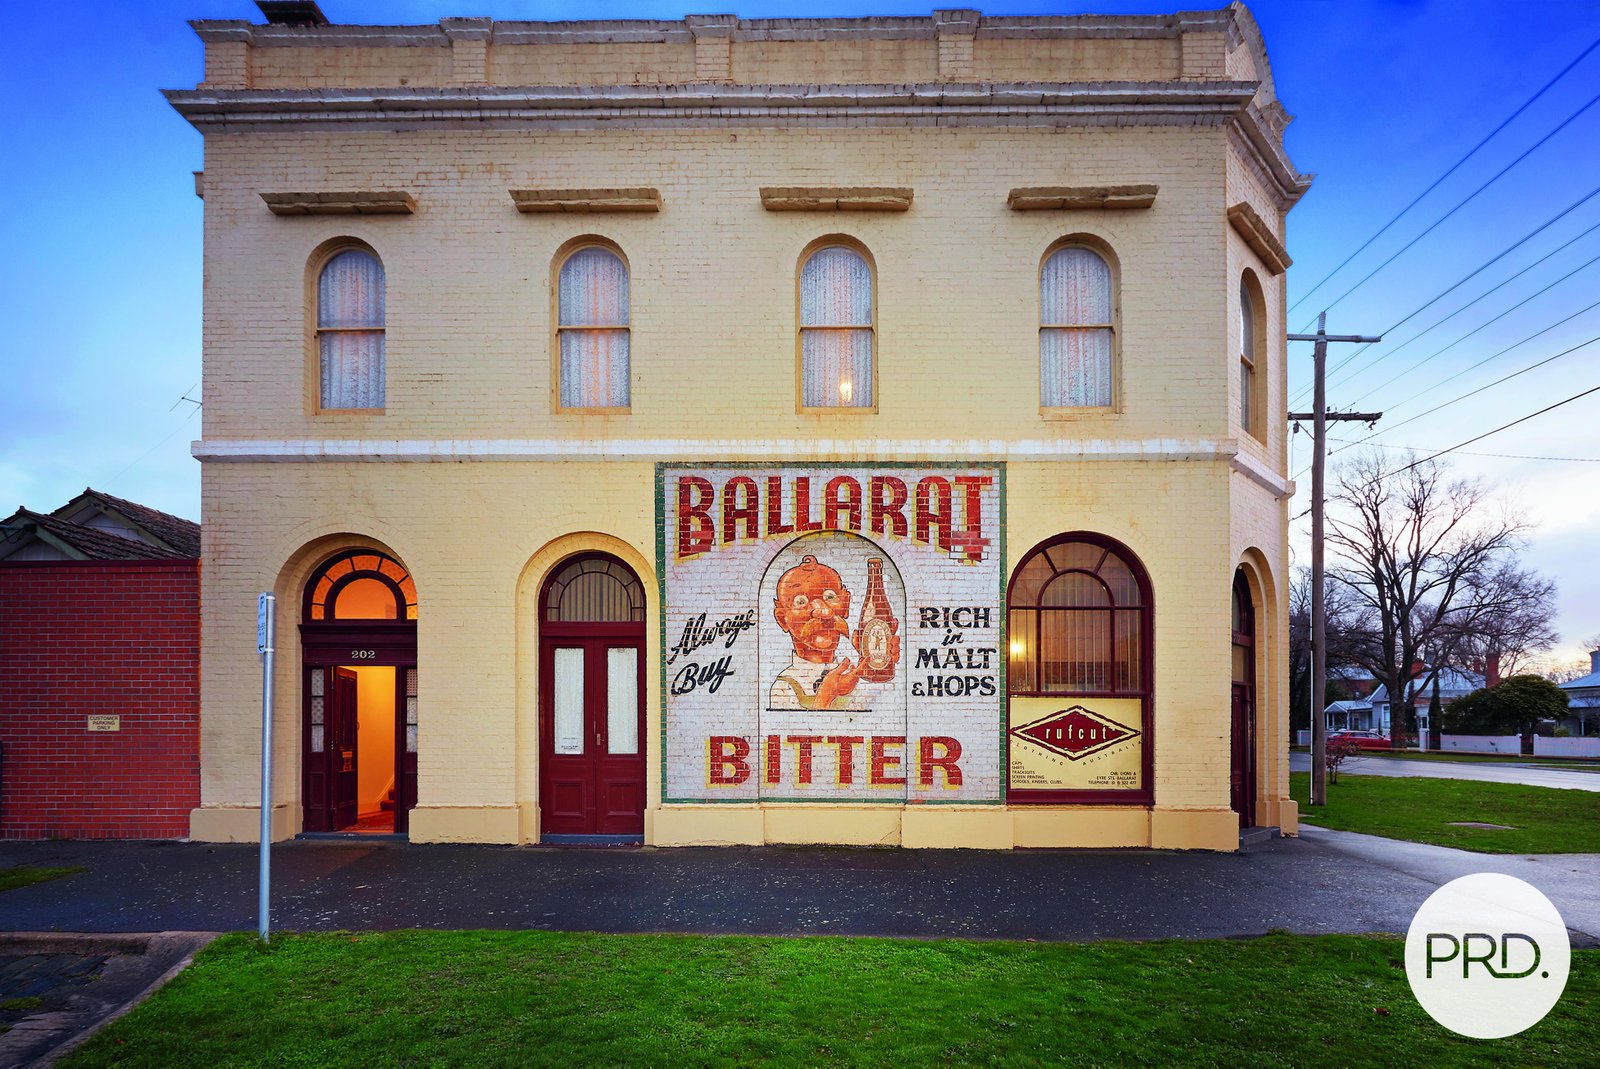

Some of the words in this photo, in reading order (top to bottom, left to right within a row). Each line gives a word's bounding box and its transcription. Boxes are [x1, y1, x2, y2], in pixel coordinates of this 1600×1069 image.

[675, 476, 993, 565] BALLARAT
[919, 606, 991, 629] RICH
[667, 609, 756, 665] Always
[941, 628, 964, 646] in
[351, 650, 376, 659] 202
[914, 648, 997, 669] MALT
[671, 655, 735, 696] Buy
[1045, 724, 1107, 740] rufcut
[707, 735, 963, 787] BITTER
